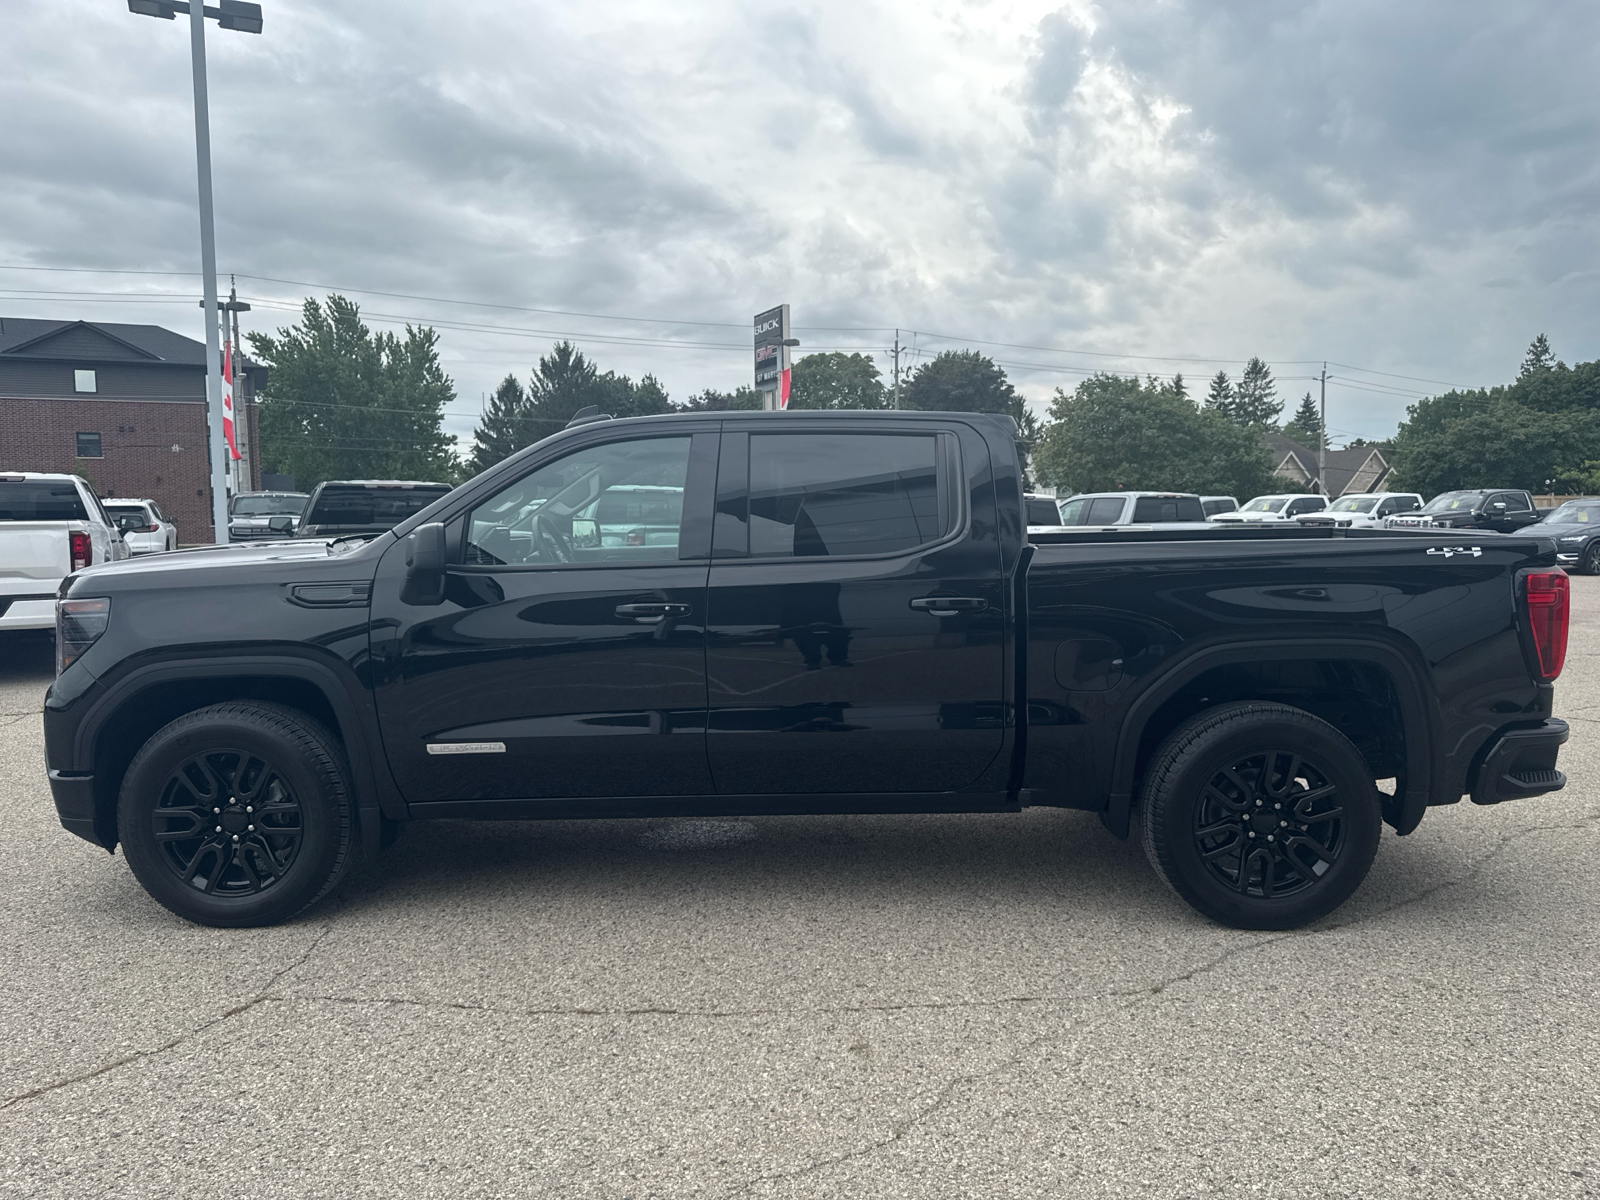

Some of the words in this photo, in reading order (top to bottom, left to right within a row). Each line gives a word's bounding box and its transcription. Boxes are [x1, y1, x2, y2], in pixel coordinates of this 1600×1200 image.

[754, 317, 779, 335] BUICK
[756, 345, 777, 362] GMC
[432, 744, 500, 752] ELEVATION
